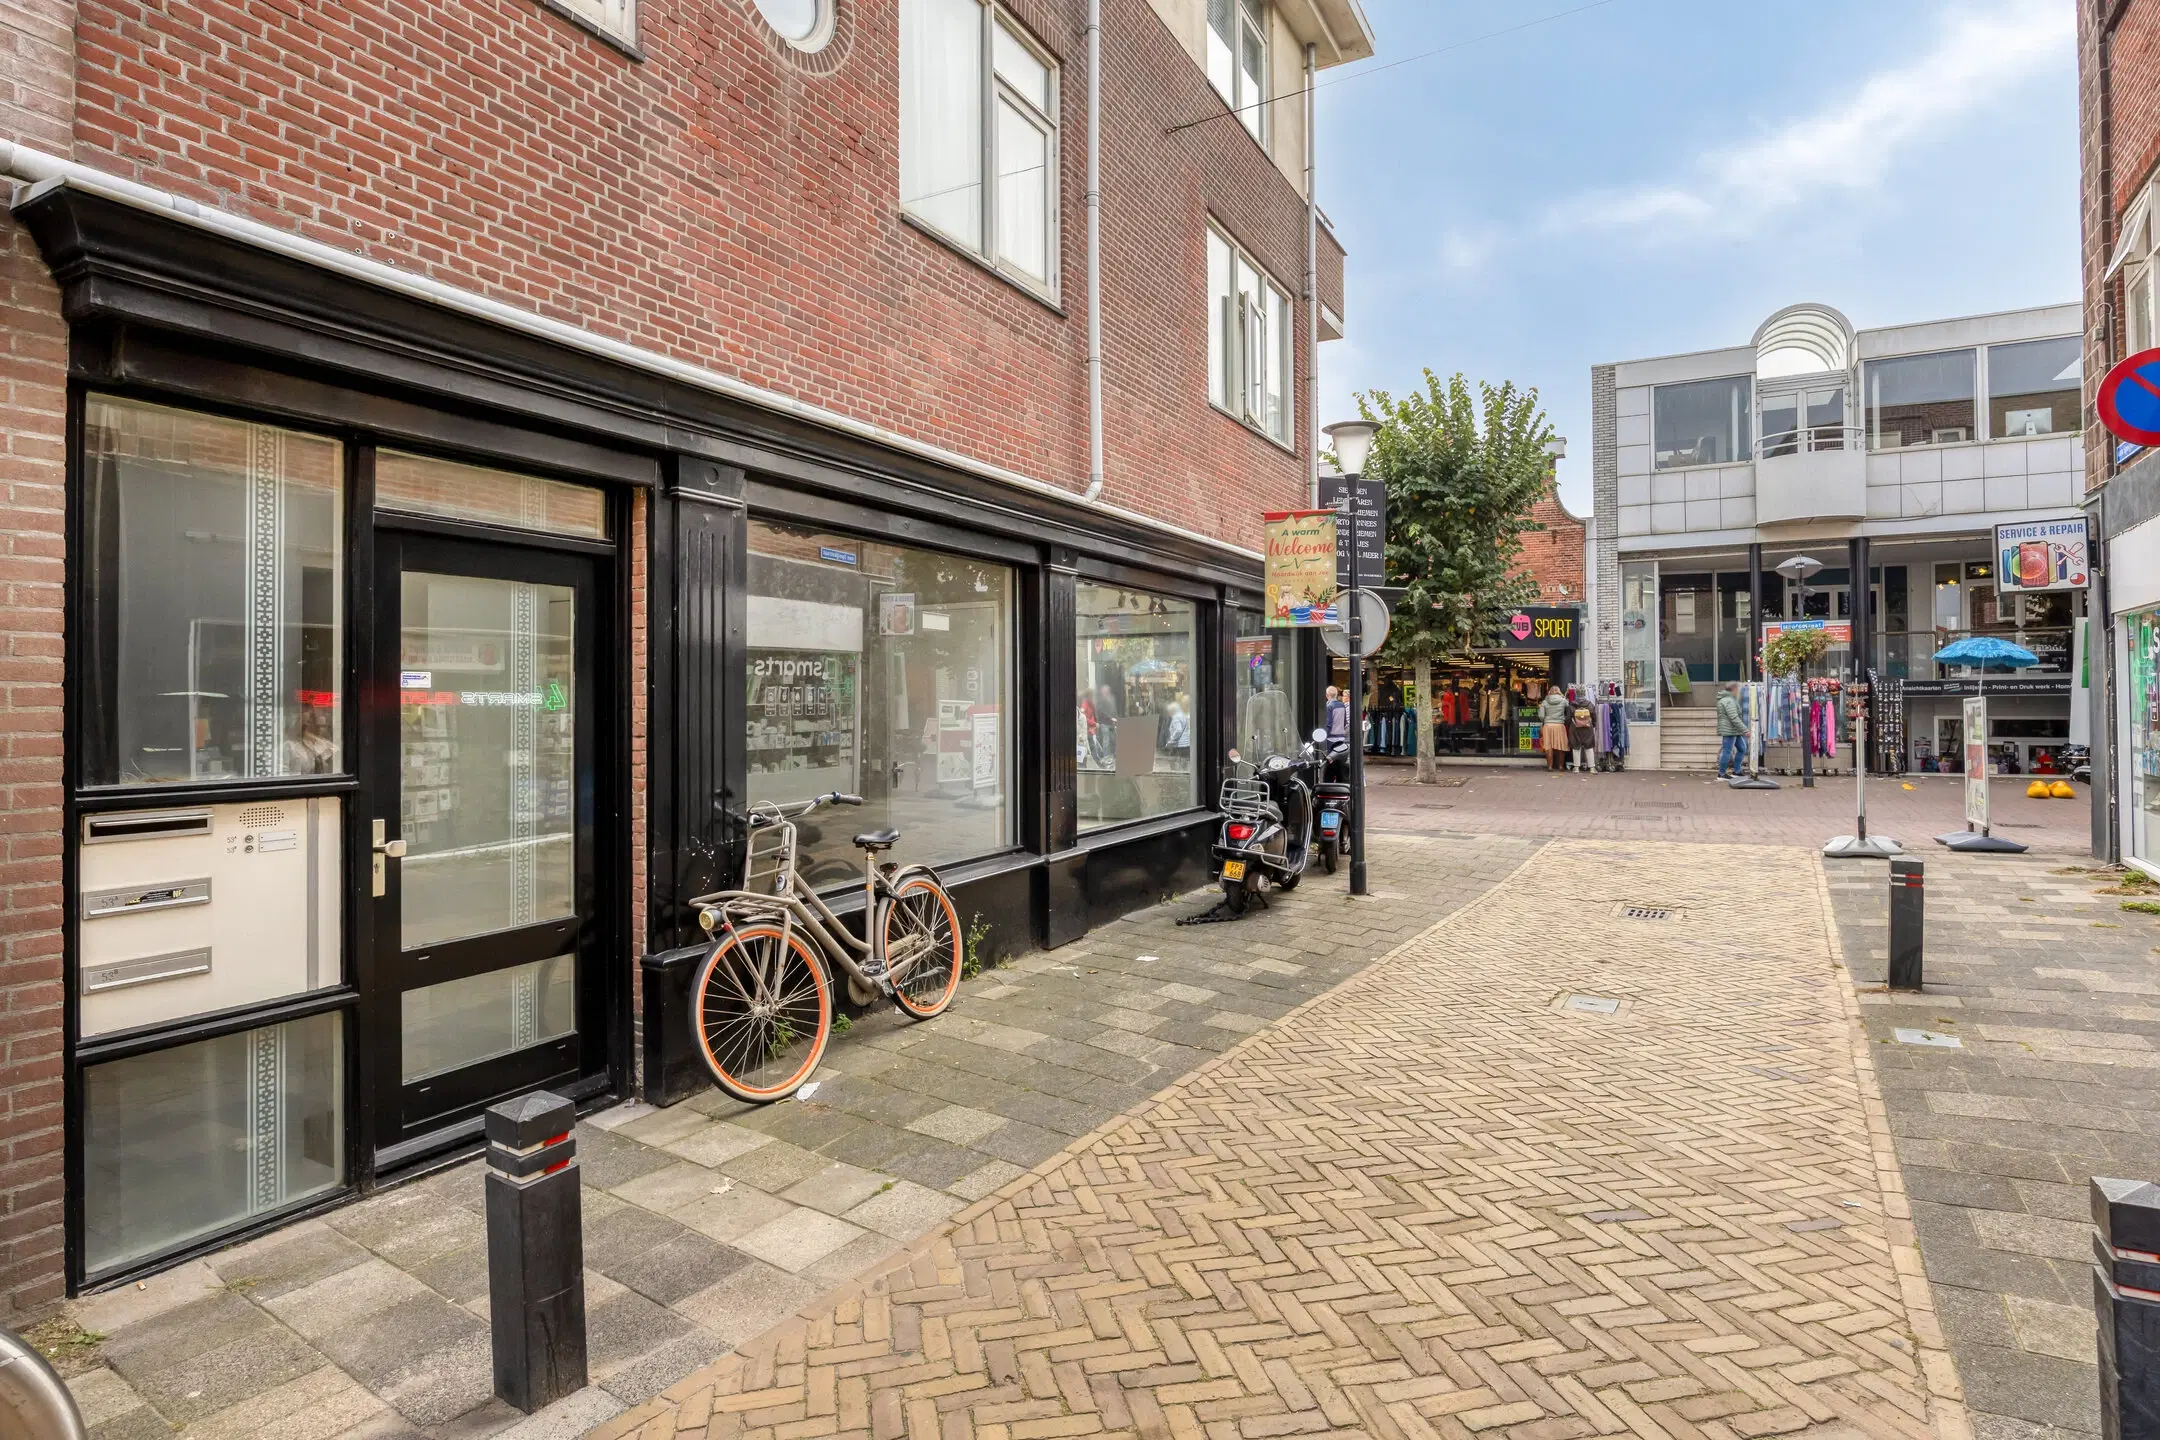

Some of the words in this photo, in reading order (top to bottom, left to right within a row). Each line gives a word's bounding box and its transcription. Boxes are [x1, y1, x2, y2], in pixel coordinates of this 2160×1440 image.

[1338, 487, 1368, 495] SIEDEN
[1281, 529, 1289, 537] A
[1999, 527, 2038, 540] SERVICE
[2040, 526, 2047, 536] &
[2049, 523, 2084, 536] REPAIR
[1268, 537, 1336, 557] Welcome
[1534, 618, 1572, 638] SPORT
